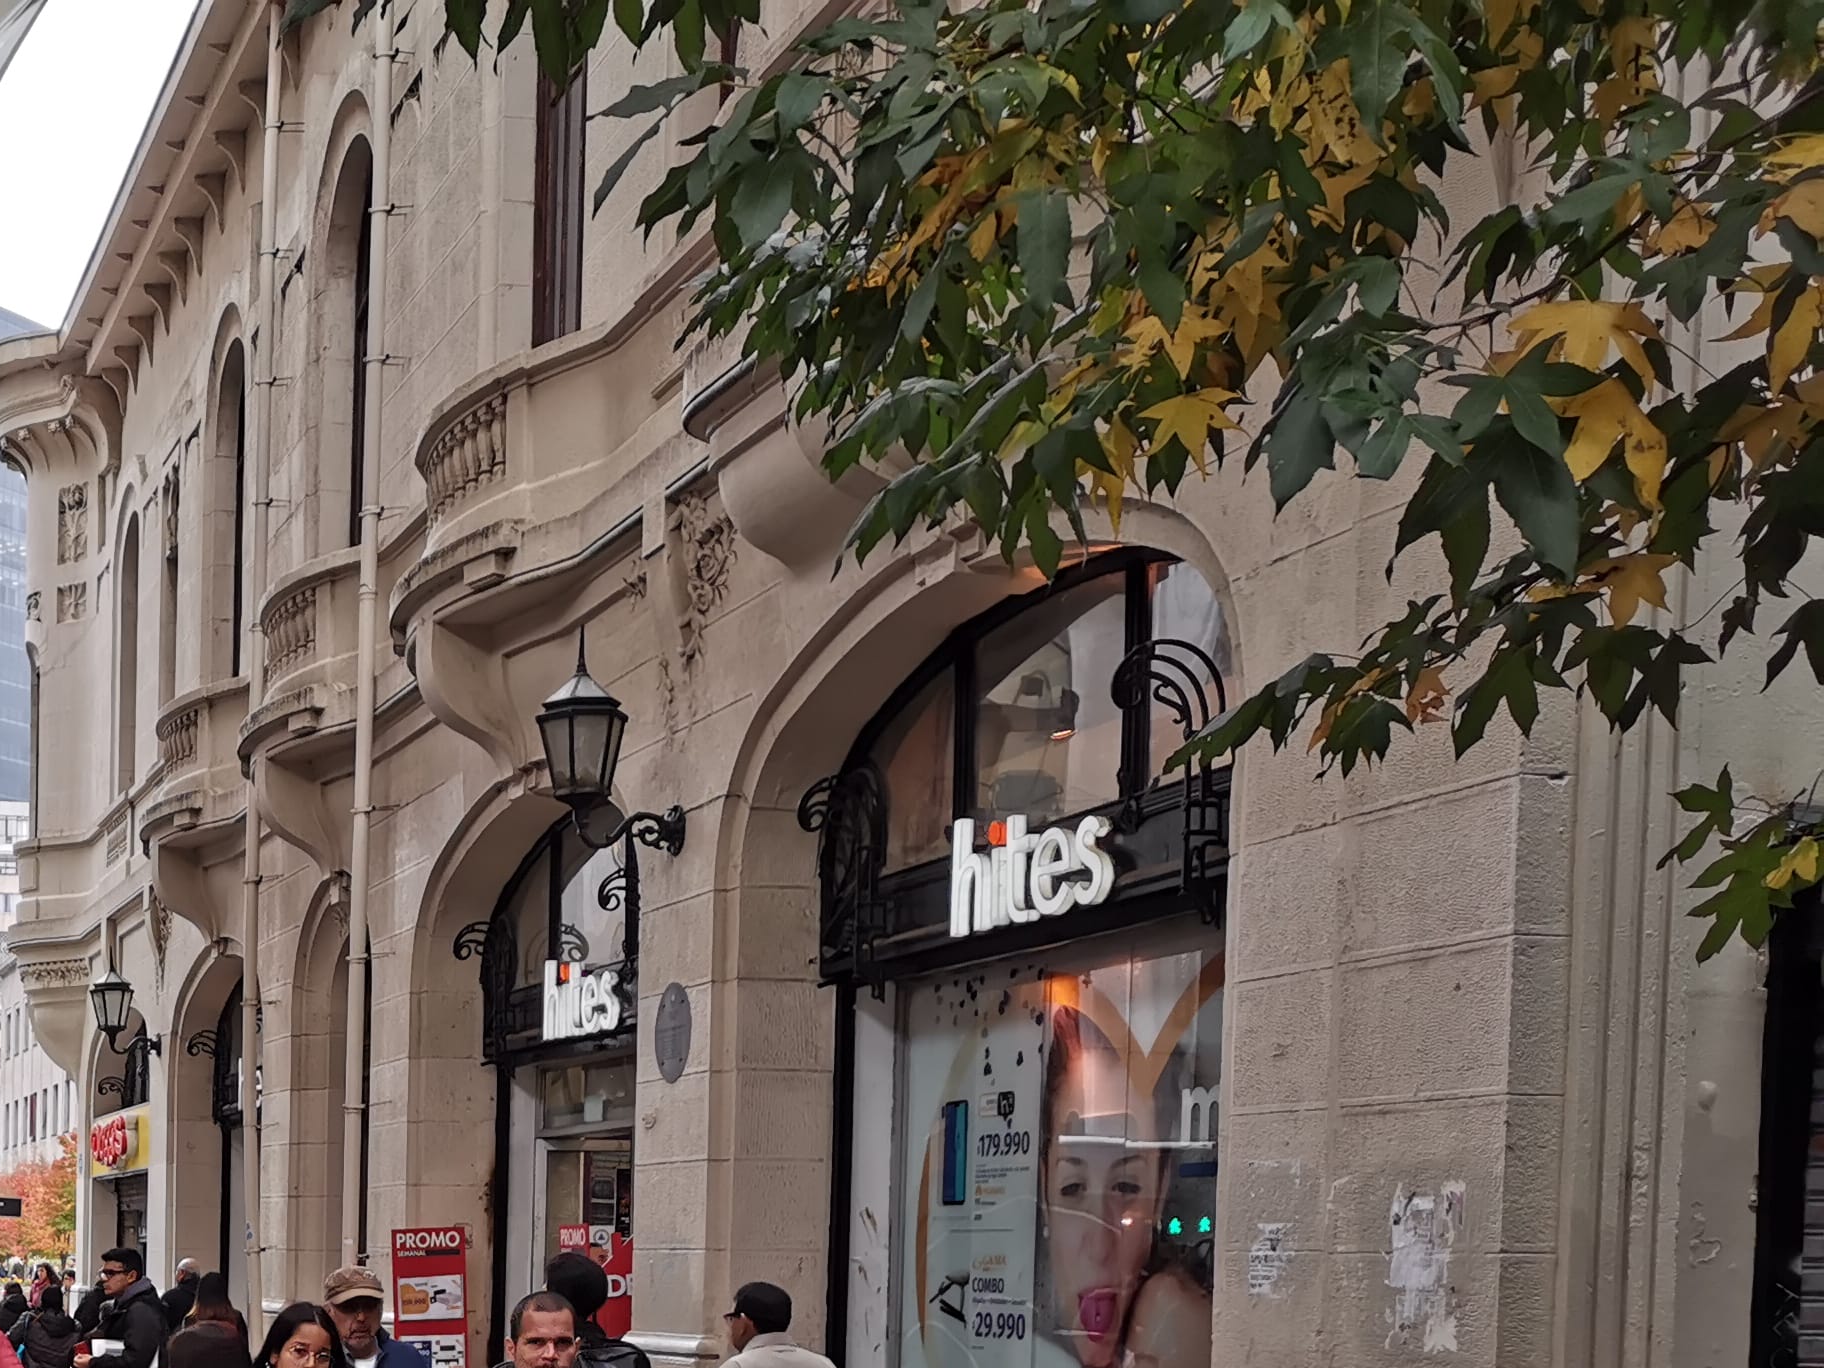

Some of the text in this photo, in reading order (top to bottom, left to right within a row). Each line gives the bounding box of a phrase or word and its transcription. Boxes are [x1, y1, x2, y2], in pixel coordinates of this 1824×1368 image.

[950, 814, 1115, 937] hites
[542, 959, 621, 1041] hites
[395, 1230, 461, 1249] PROMO
[560, 1228, 586, 1246] PROMO
[972, 1277, 1005, 1293] COMBO
